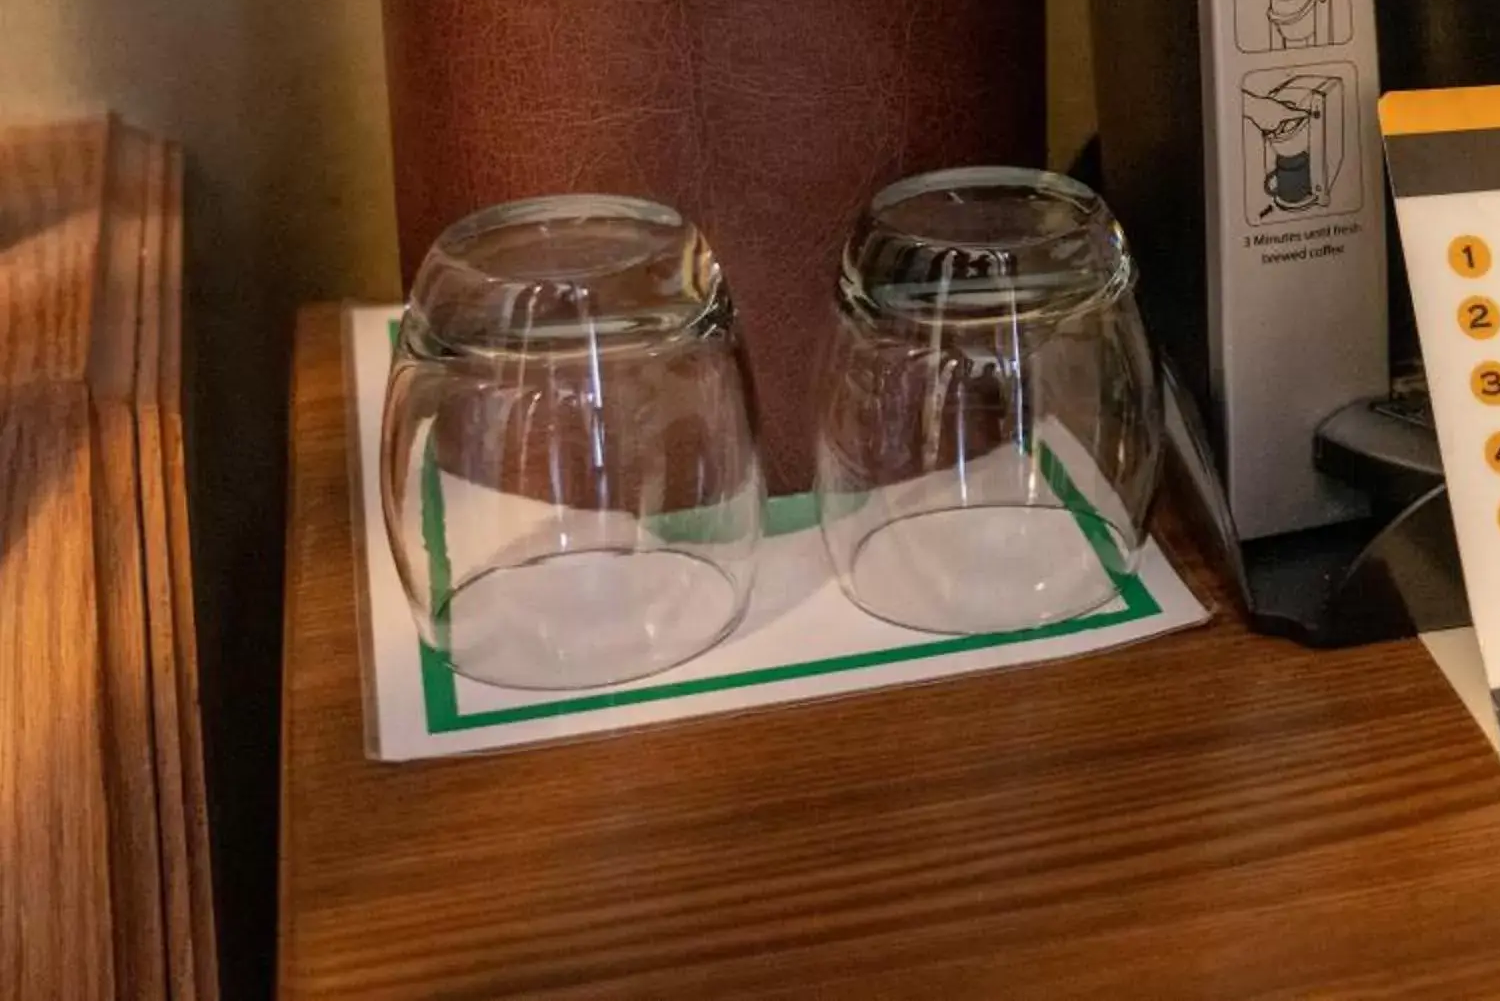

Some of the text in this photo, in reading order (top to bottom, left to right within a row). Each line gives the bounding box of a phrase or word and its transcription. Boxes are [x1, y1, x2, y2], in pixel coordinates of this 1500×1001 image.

[1253, 232, 1302, 246] Minutes
[1262, 249, 1307, 264] brewed
[1461, 244, 1475, 269] 1
[1467, 305, 1493, 329] 2
